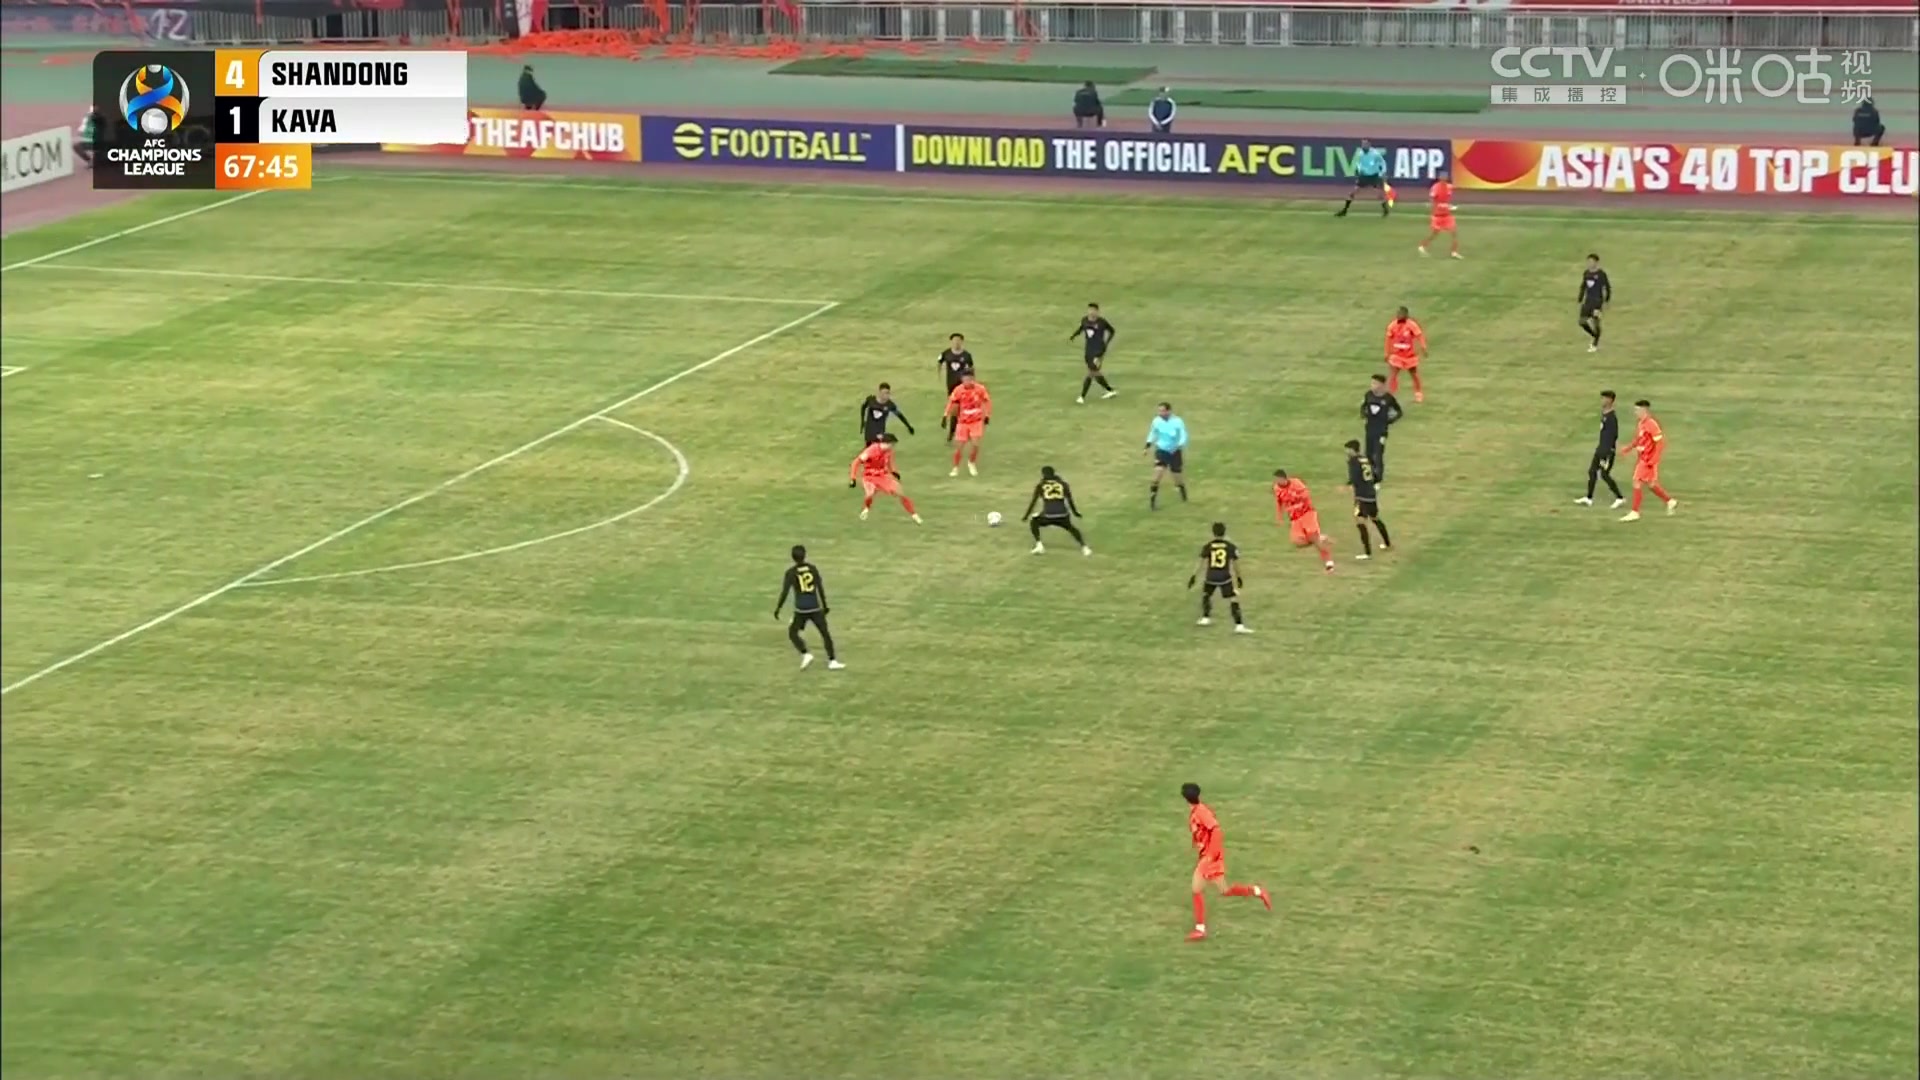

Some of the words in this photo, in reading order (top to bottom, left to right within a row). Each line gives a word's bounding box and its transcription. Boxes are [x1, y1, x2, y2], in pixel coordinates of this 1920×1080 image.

[467, 117, 625, 153] THEAFCHUB
[911, 133, 1046, 169] DOWNLOAD
[1052, 138, 1097, 171] THE
[1103, 139, 1212, 174] OFFICIAL
[1217, 143, 1296, 176] AFC
[1302, 145, 1387, 178] LIV
[1393, 147, 1445, 179] APP
[1537, 145, 1669, 192] ASIA'S
[1680, 147, 1738, 192] 40
[1750, 149, 1829, 193] TOP
[1042, 483, 1064, 499] 23
[1210, 548, 1227, 568] 13
[797, 571, 815, 593] 12
